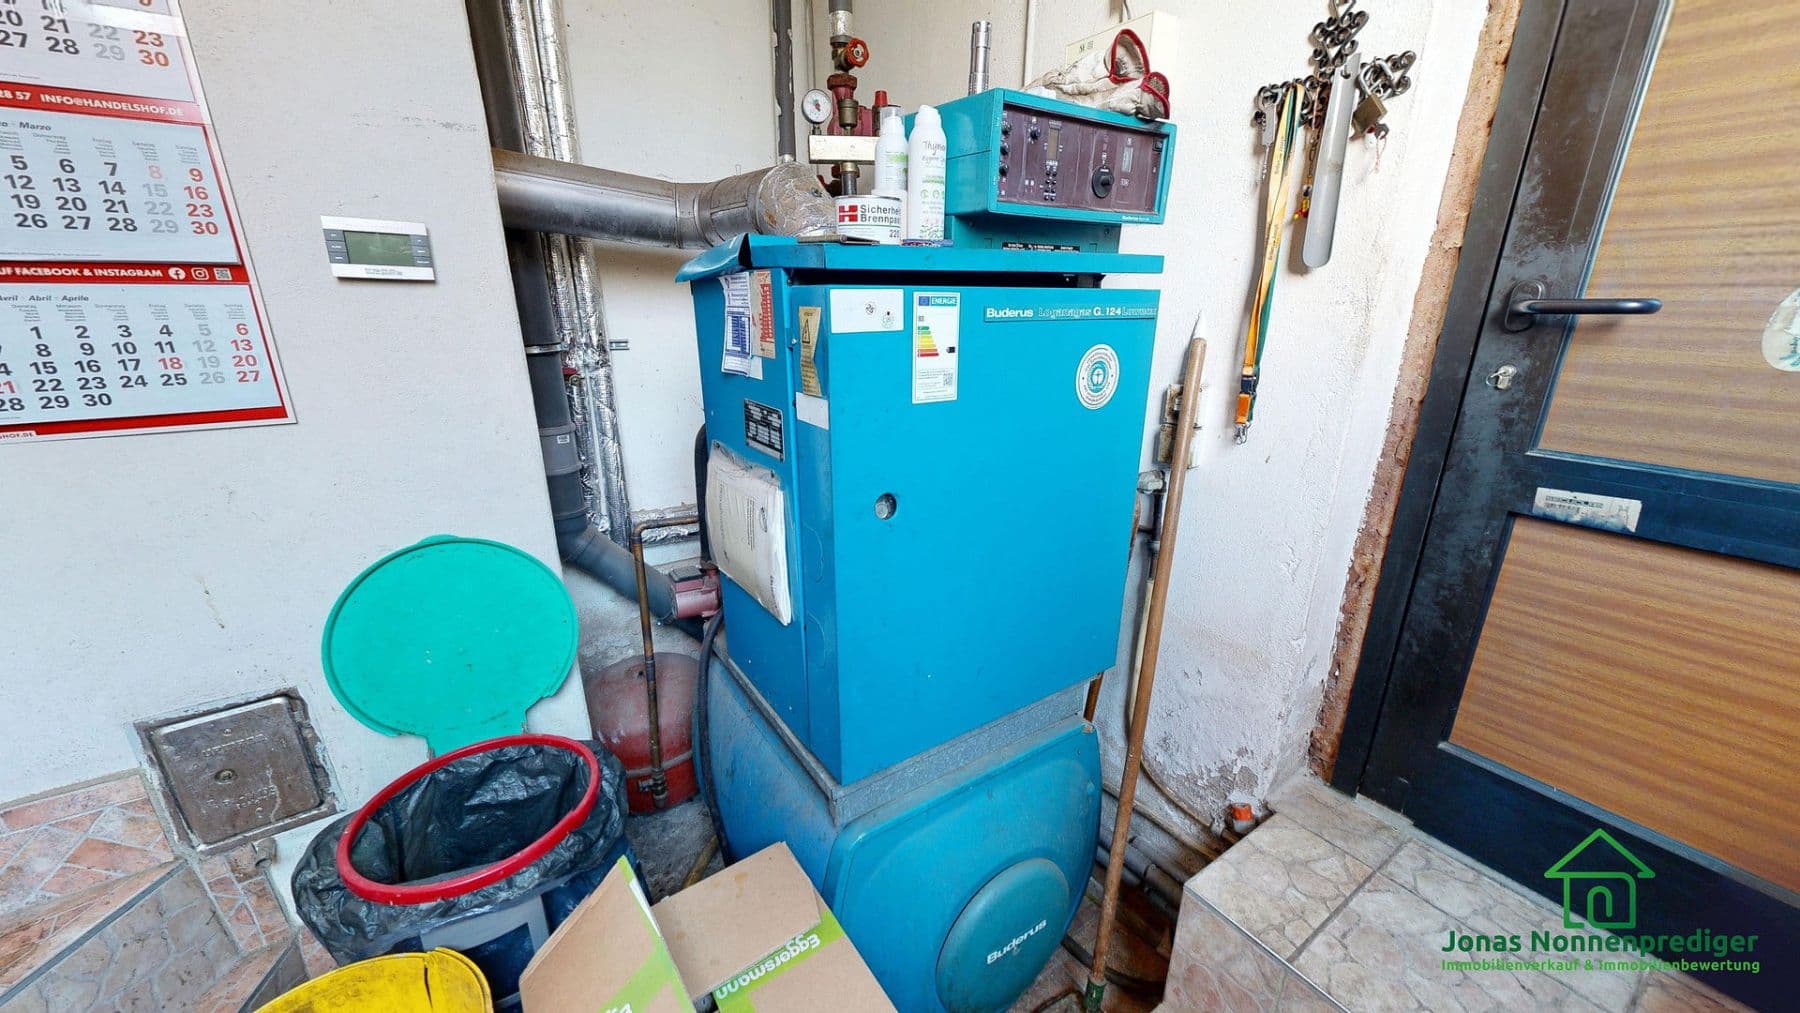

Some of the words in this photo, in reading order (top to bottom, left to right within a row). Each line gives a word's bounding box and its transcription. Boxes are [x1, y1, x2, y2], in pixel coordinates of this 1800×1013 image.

[41, 16, 69, 33] 21
[88, 23, 121, 41] 22
[133, 29, 165, 47] 23
[0, 30, 27, 47] 27
[46, 37, 79, 54] 28
[93, 43, 126, 61] 29
[139, 50, 169, 68] 30
[15, 91, 31, 100] 57
[40, 93, 184, 117] INFO@HANDELSHOF.DE
[19, 121, 51, 131] Marzo
[11, 155, 28, 170] 5
[60, 159, 75, 173] 6
[104, 162, 117, 176] 7
[148, 165, 163, 181] 8
[189, 168, 203, 182] 9
[4, 175, 35, 190] 12
[53, 178, 81, 192] 13
[98, 181, 126, 195] 14
[142, 183, 168, 198] 15
[184, 186, 208, 200] 16
[11, 194, 40, 209] 19
[56, 197, 87, 211] 20
[103, 199, 129, 213] 21
[144, 201, 174, 216] 22
[186, 204, 213, 217] 23
[14, 213, 48, 228] 26
[62, 215, 90, 230] 27
[107, 217, 137, 232] 28
[152, 218, 179, 233] 29
[191, 221, 218, 235] 30
[15, 268, 81, 276] FACEBOOK
[83, 268, 92, 276] &
[94, 268, 163, 278] INSTAGRAM
[986, 307, 1033, 318] Buderus
[1106, 307, 1121, 315] 124
[30, 326, 42, 339] 1
[75, 326, 90, 338] 2
[117, 325, 132, 337] 3
[160, 325, 173, 337] 4
[198, 324, 211, 336] 5
[235, 323, 248, 337] 6
[36, 344, 51, 357] 8
[80, 343, 94, 355] 9
[112, 342, 137, 354] 10
[155, 341, 175, 353] 11
[193, 339, 216, 353] 12
[231, 339, 254, 351] 13
[30, 362, 57, 374] 15
[75, 360, 101, 373] 16
[118, 359, 140, 371] 17
[158, 357, 184, 369] 18
[197, 356, 220, 369] 19
[232, 355, 258, 368] 20
[33, 379, 64, 392] 22
[77, 377, 106, 390] 23
[120, 375, 148, 388] 24
[160, 373, 188, 387] 25
[199, 372, 225, 385] 26
[237, 371, 259, 382] 27
[39, 396, 69, 409] 29
[83, 393, 112, 406] 30
[987, 920, 1047, 965] Buderus
[716, 934, 820, 999] Eggersmann
